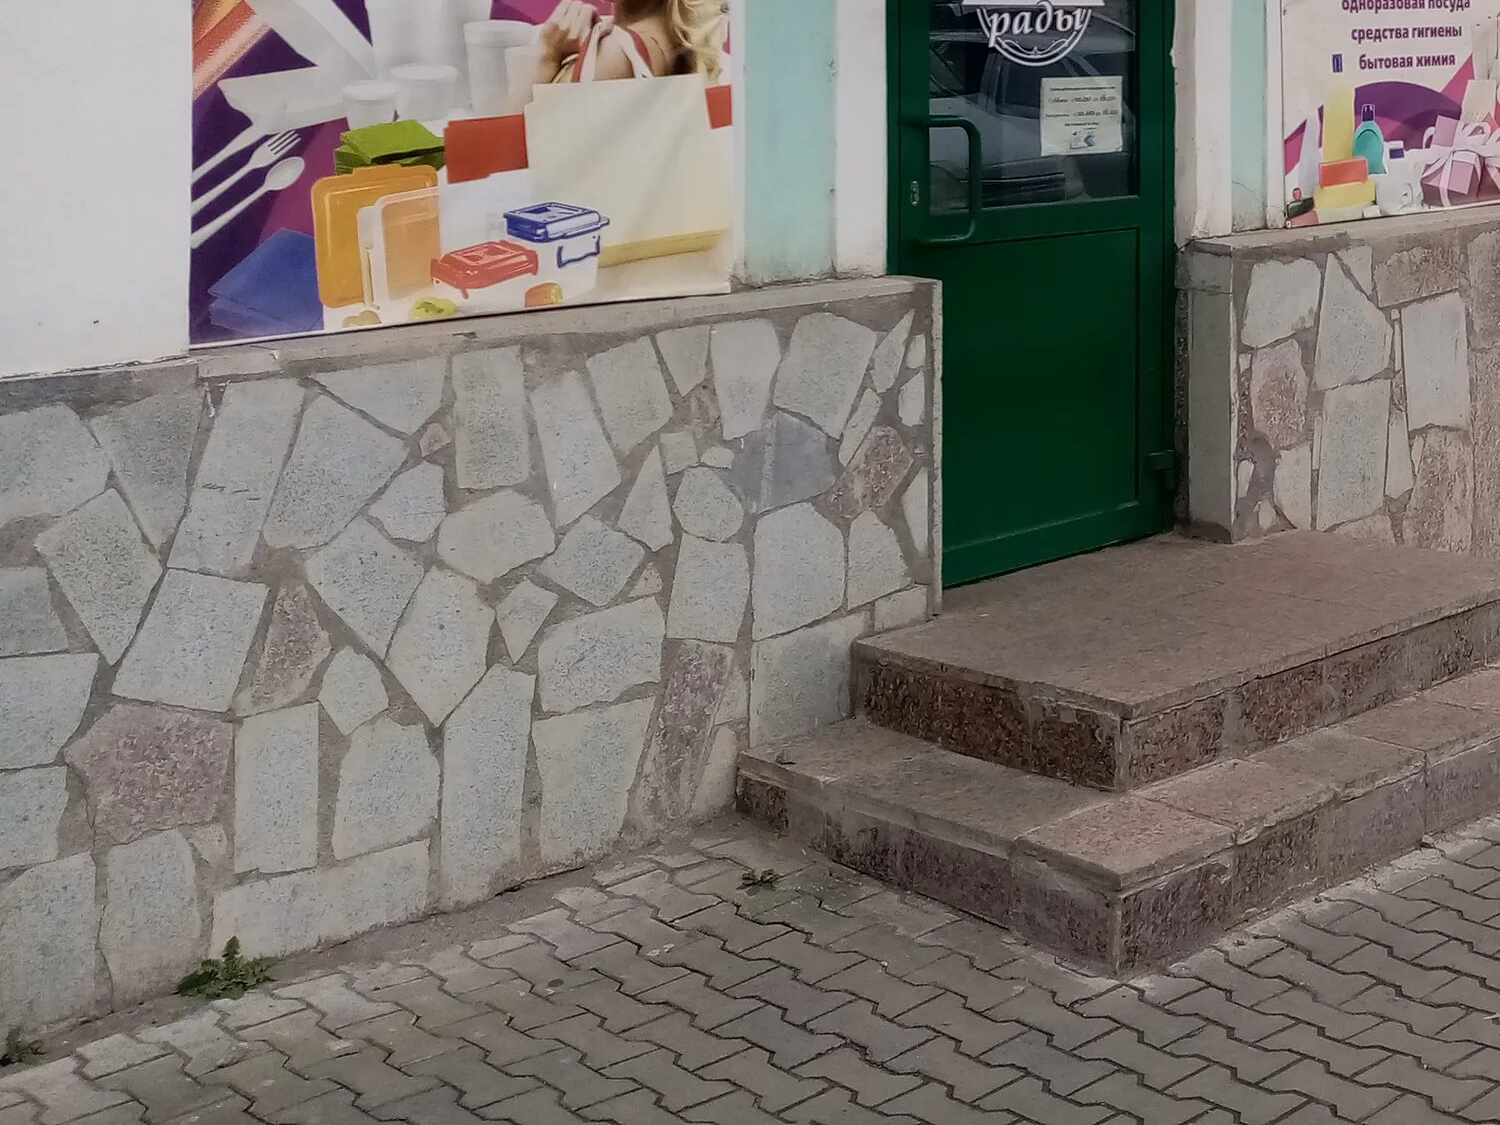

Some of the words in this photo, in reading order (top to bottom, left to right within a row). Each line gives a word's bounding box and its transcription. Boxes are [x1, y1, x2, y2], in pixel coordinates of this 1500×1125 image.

[988, 0, 1084, 49] рады
[1351, 28, 1409, 45] средства
[1411, 26, 1462, 39] гигиены
[1359, 55, 1413, 70] бытовая
[1415, 55, 1456, 68] химия
